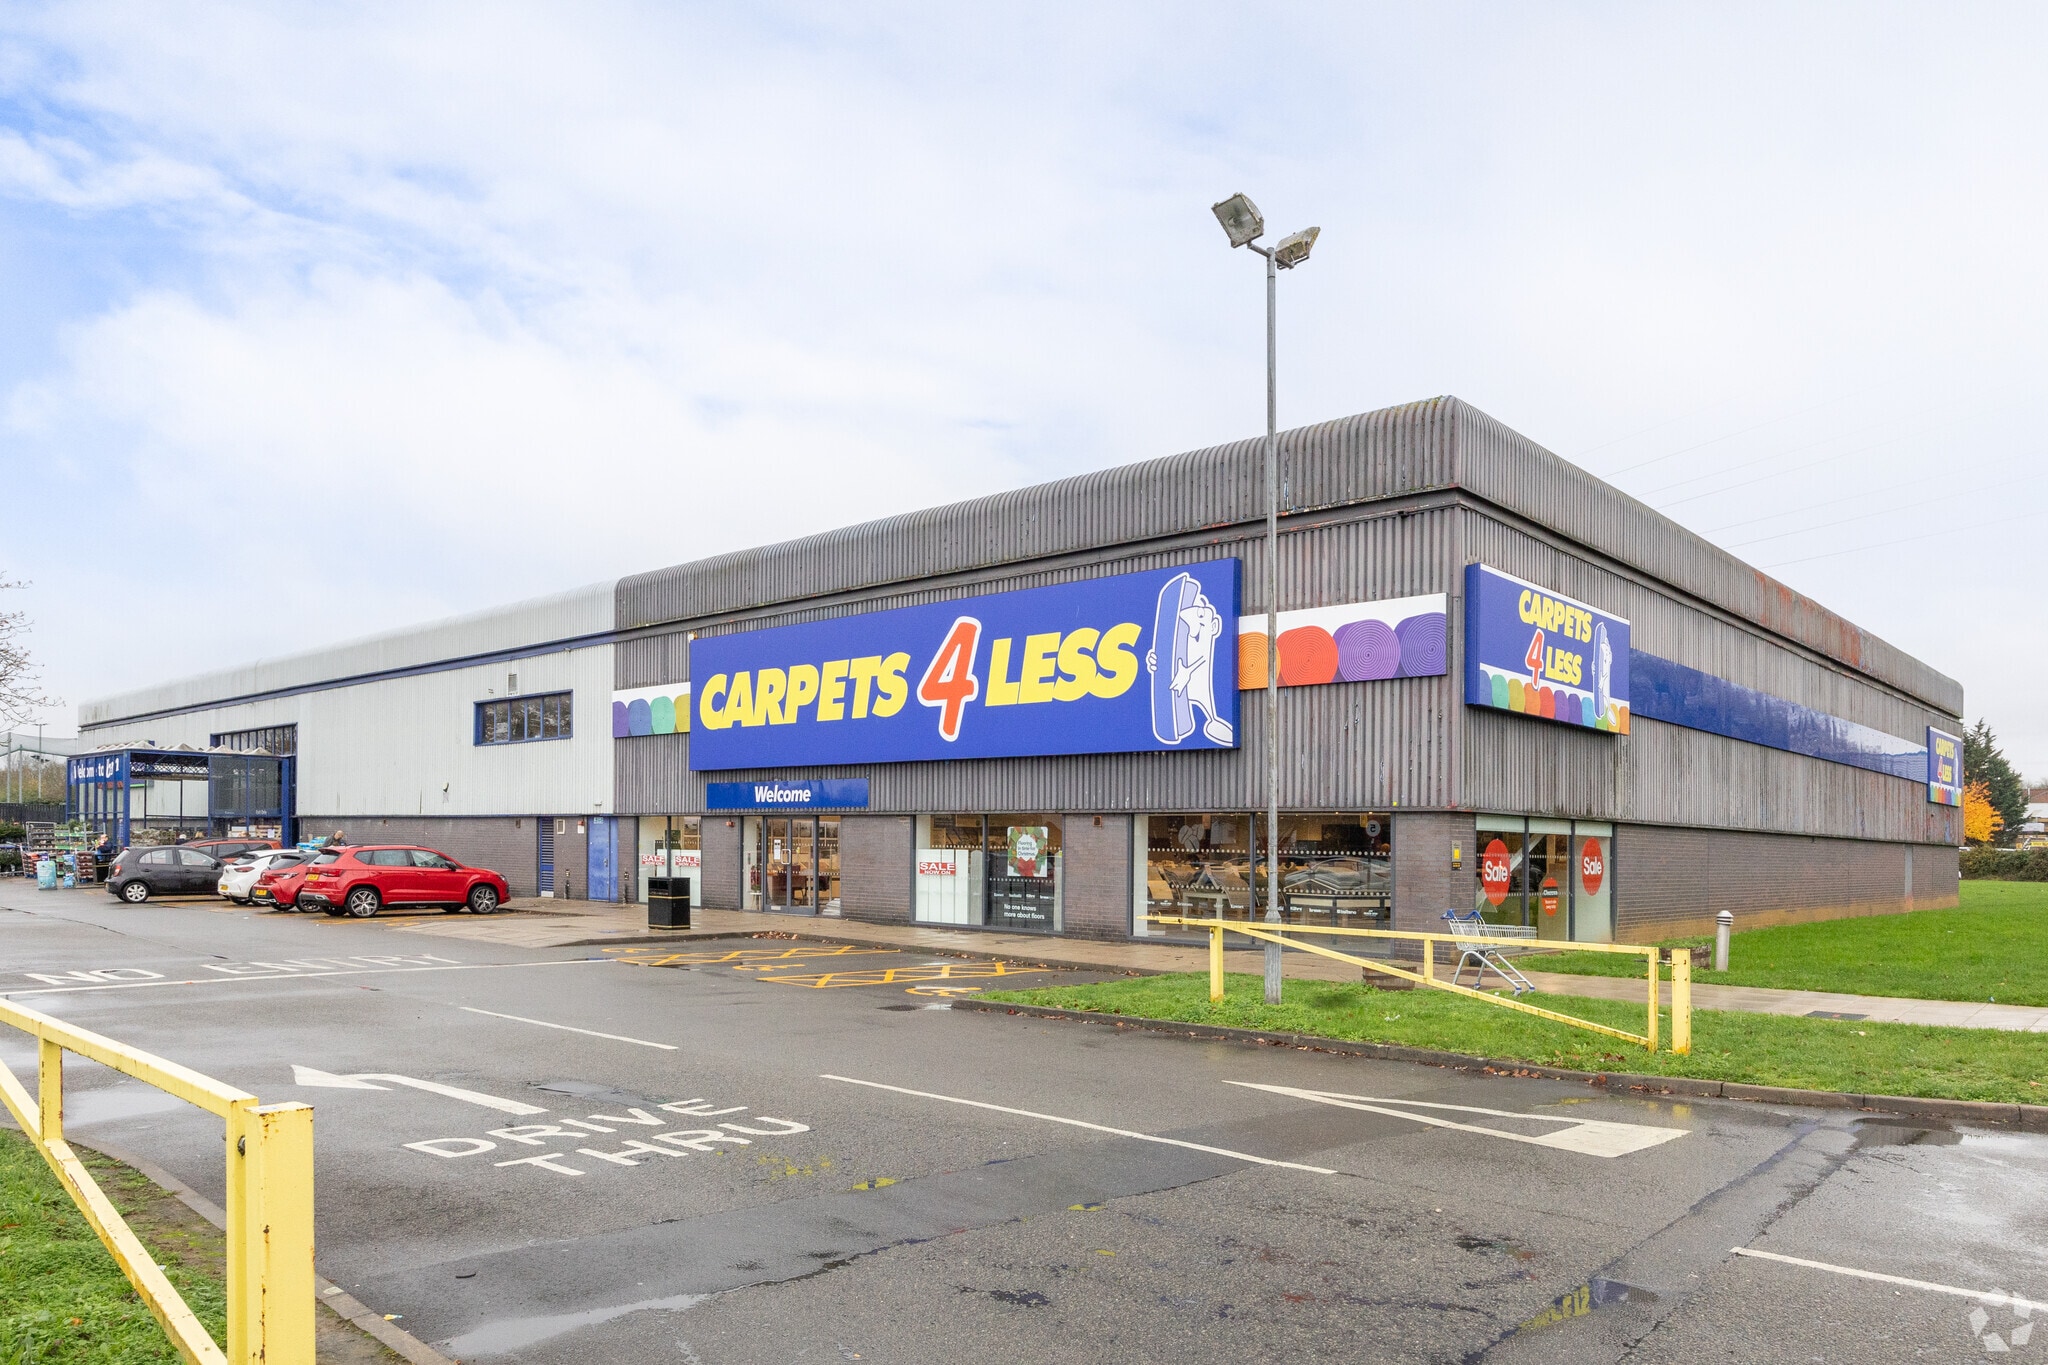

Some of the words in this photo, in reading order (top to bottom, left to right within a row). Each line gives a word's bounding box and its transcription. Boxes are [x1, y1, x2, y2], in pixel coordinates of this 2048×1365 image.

[1518, 589, 1593, 644] CARPETS
[1524, 628, 1545, 690] 4
[1545, 644, 1582, 686] LESS
[699, 651, 911, 731] CARPETS
[916, 615, 982, 743] 4
[985, 622, 1142, 707] LESS
[754, 784, 812, 803] Welcome
[642, 855, 665, 863] SALE
[675, 856, 700, 864] SALE
[919, 862, 956, 871] SALE
[1583, 856, 1602, 876] Sale
[1484, 860, 1509, 882] Sale
[1031, 912, 1045, 920] floors
[25, 968, 164, 985] NO
[202, 953, 463, 975] ENTRY
[402, 1098, 749, 1159] DRIVE
[493, 1116, 811, 1176] THRU
